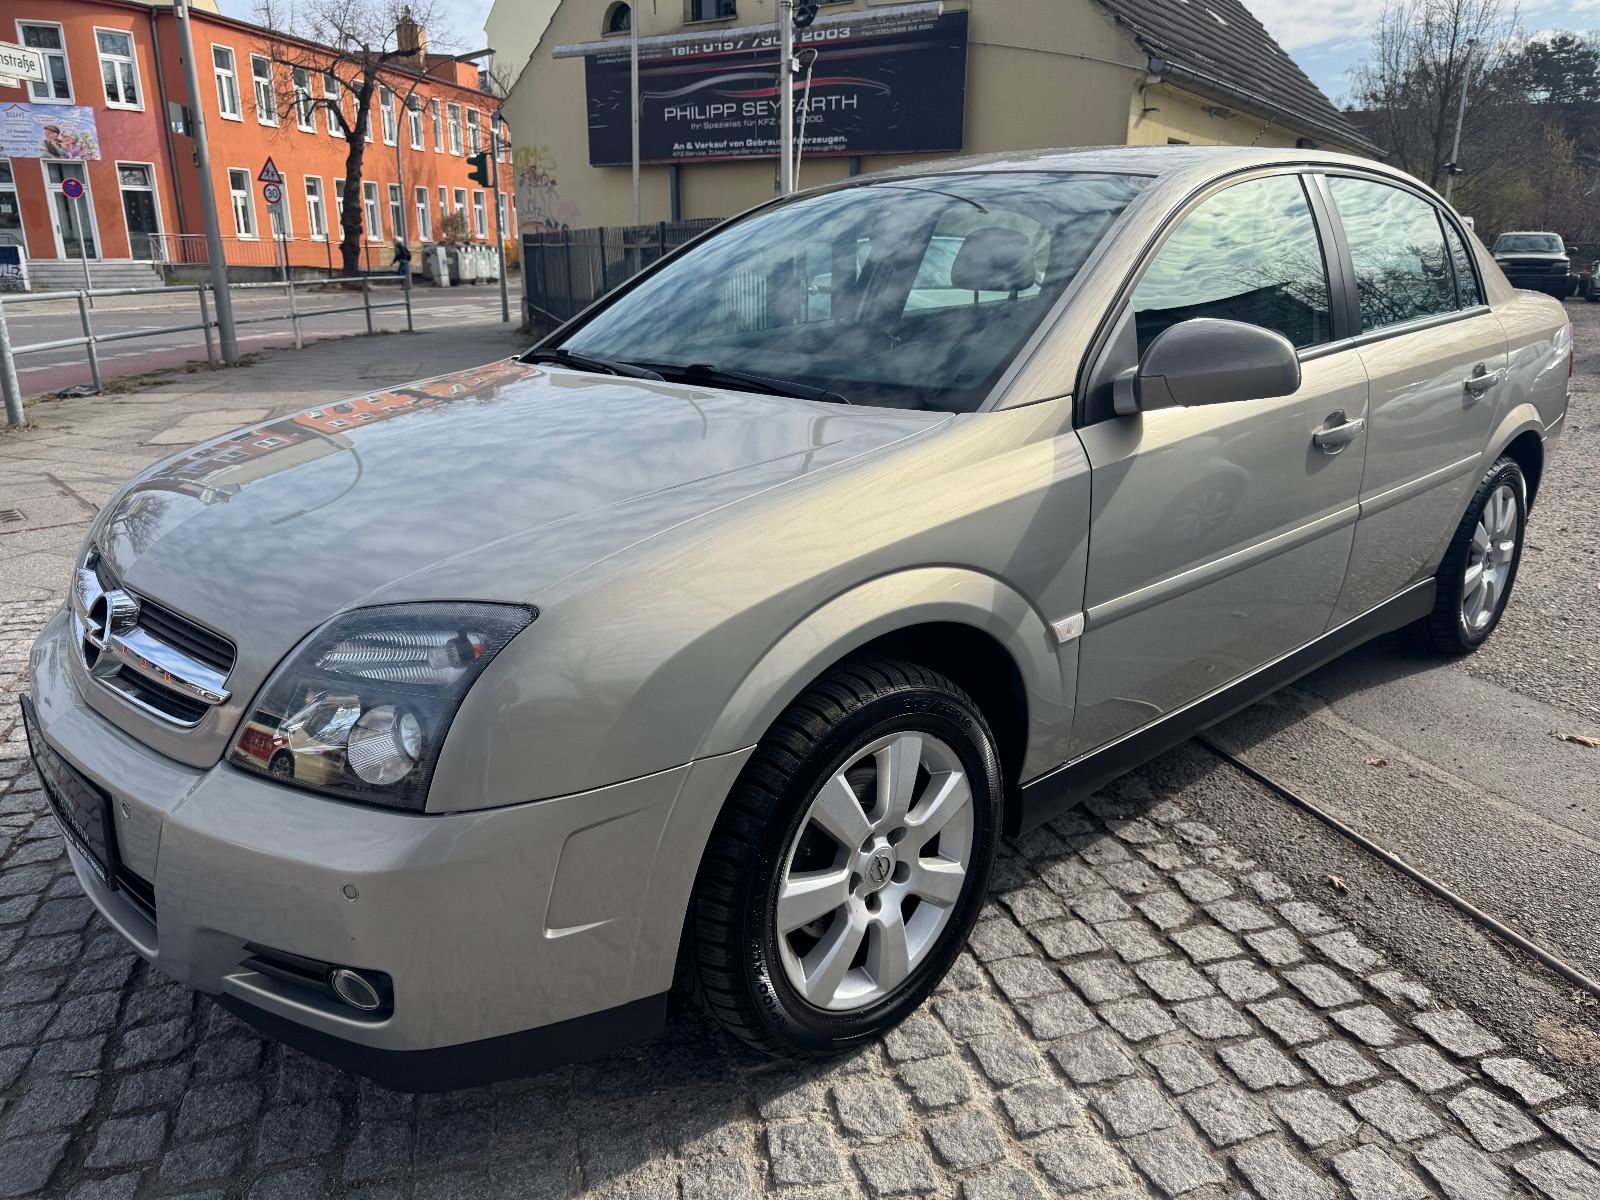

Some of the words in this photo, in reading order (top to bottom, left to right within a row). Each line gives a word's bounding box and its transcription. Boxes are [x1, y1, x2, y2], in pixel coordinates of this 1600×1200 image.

[801, 27, 851, 42] 2003
[664, 102, 737, 121] PHILIPP
[758, 117, 776, 126] KFZ
[673, 143, 685, 151] An
[686, 142, 693, 150] &
[694, 139, 728, 149] Verkauf
[729, 140, 744, 148] von
[266, 188, 279, 199] 30
